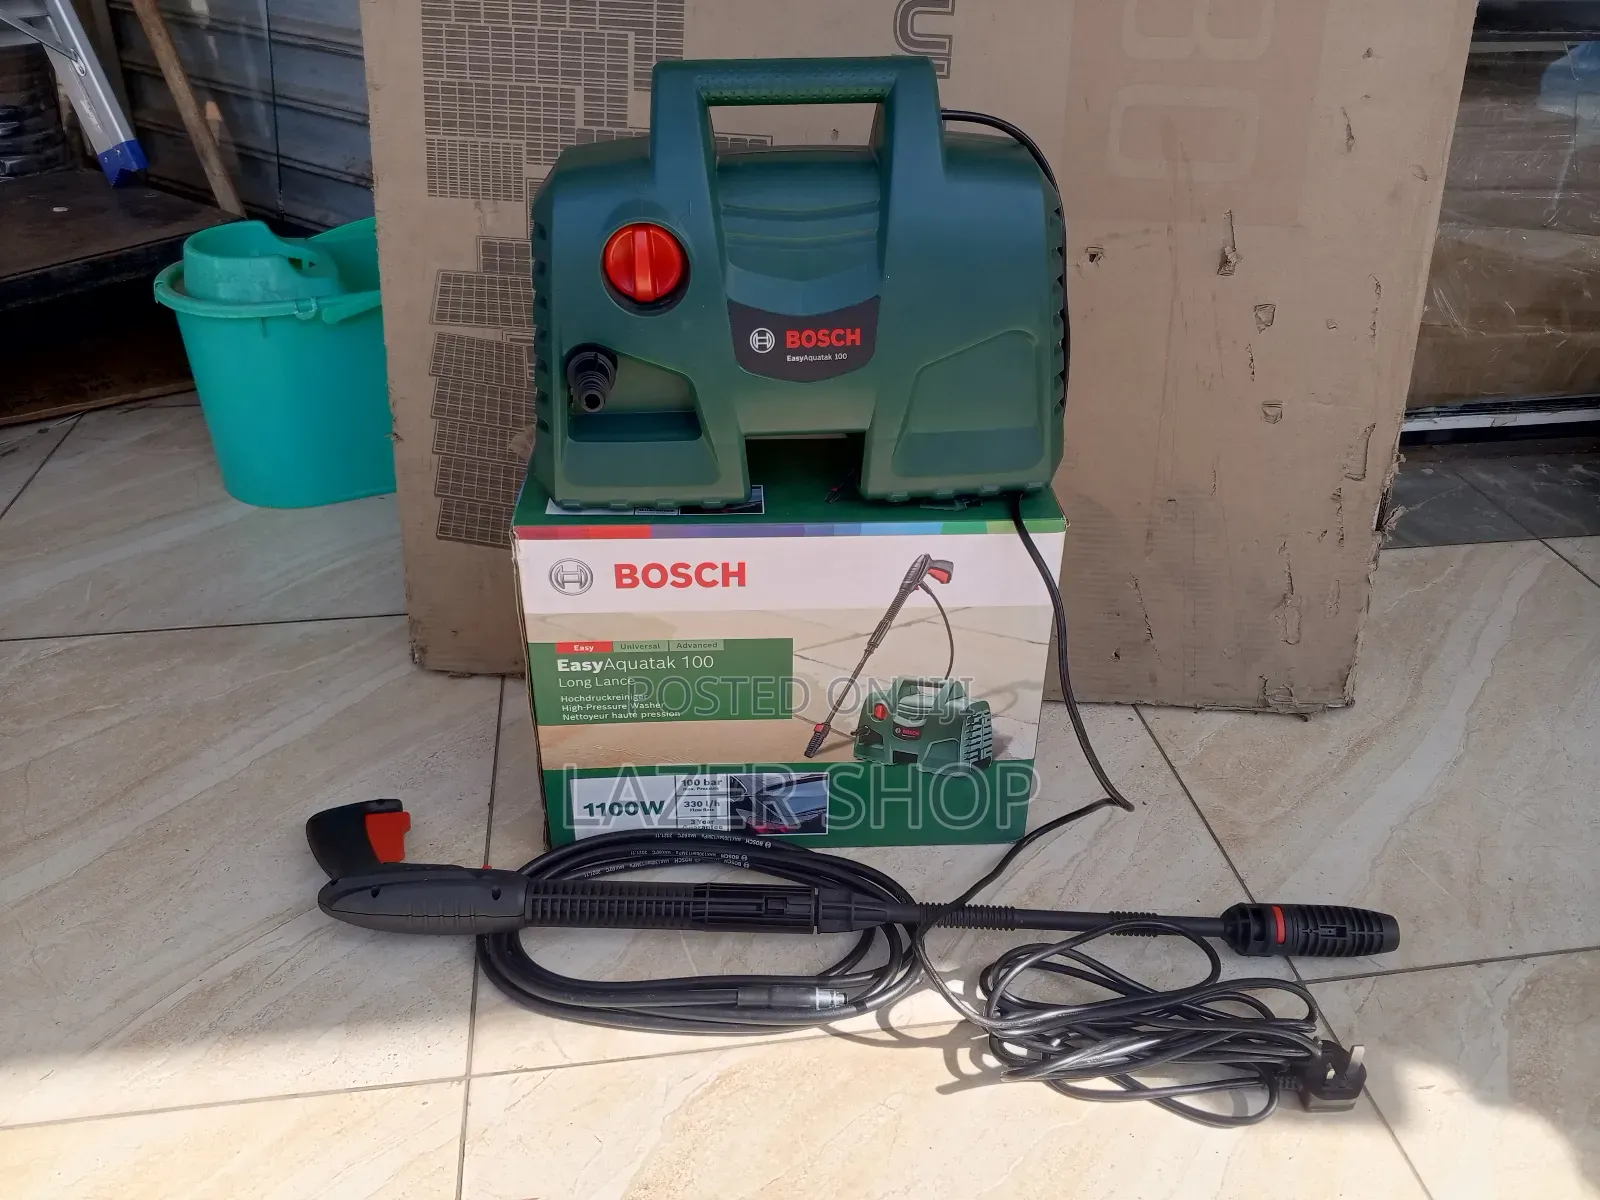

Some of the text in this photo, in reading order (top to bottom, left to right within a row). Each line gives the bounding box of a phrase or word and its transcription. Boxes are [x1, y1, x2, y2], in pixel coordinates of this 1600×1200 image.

[786, 328, 861, 348] BOSCH
[787, 353, 848, 363] EasyAquatak 100
[614, 561, 747, 589] BOSCH
[574, 644, 595, 652] Easy
[557, 655, 714, 674] EasyAquatak 100
[558, 676, 635, 689] Long Lance
[562, 702, 665, 713] High-Pressure Washer
[562, 713, 609, 721] Nettoyeur
[641, 711, 681, 719] pression
[681, 778, 723, 787] 100 bar
[683, 800, 703, 808] 330
[583, 801, 665, 818] 1100W
[745, 838, 763, 847] BOSCH
